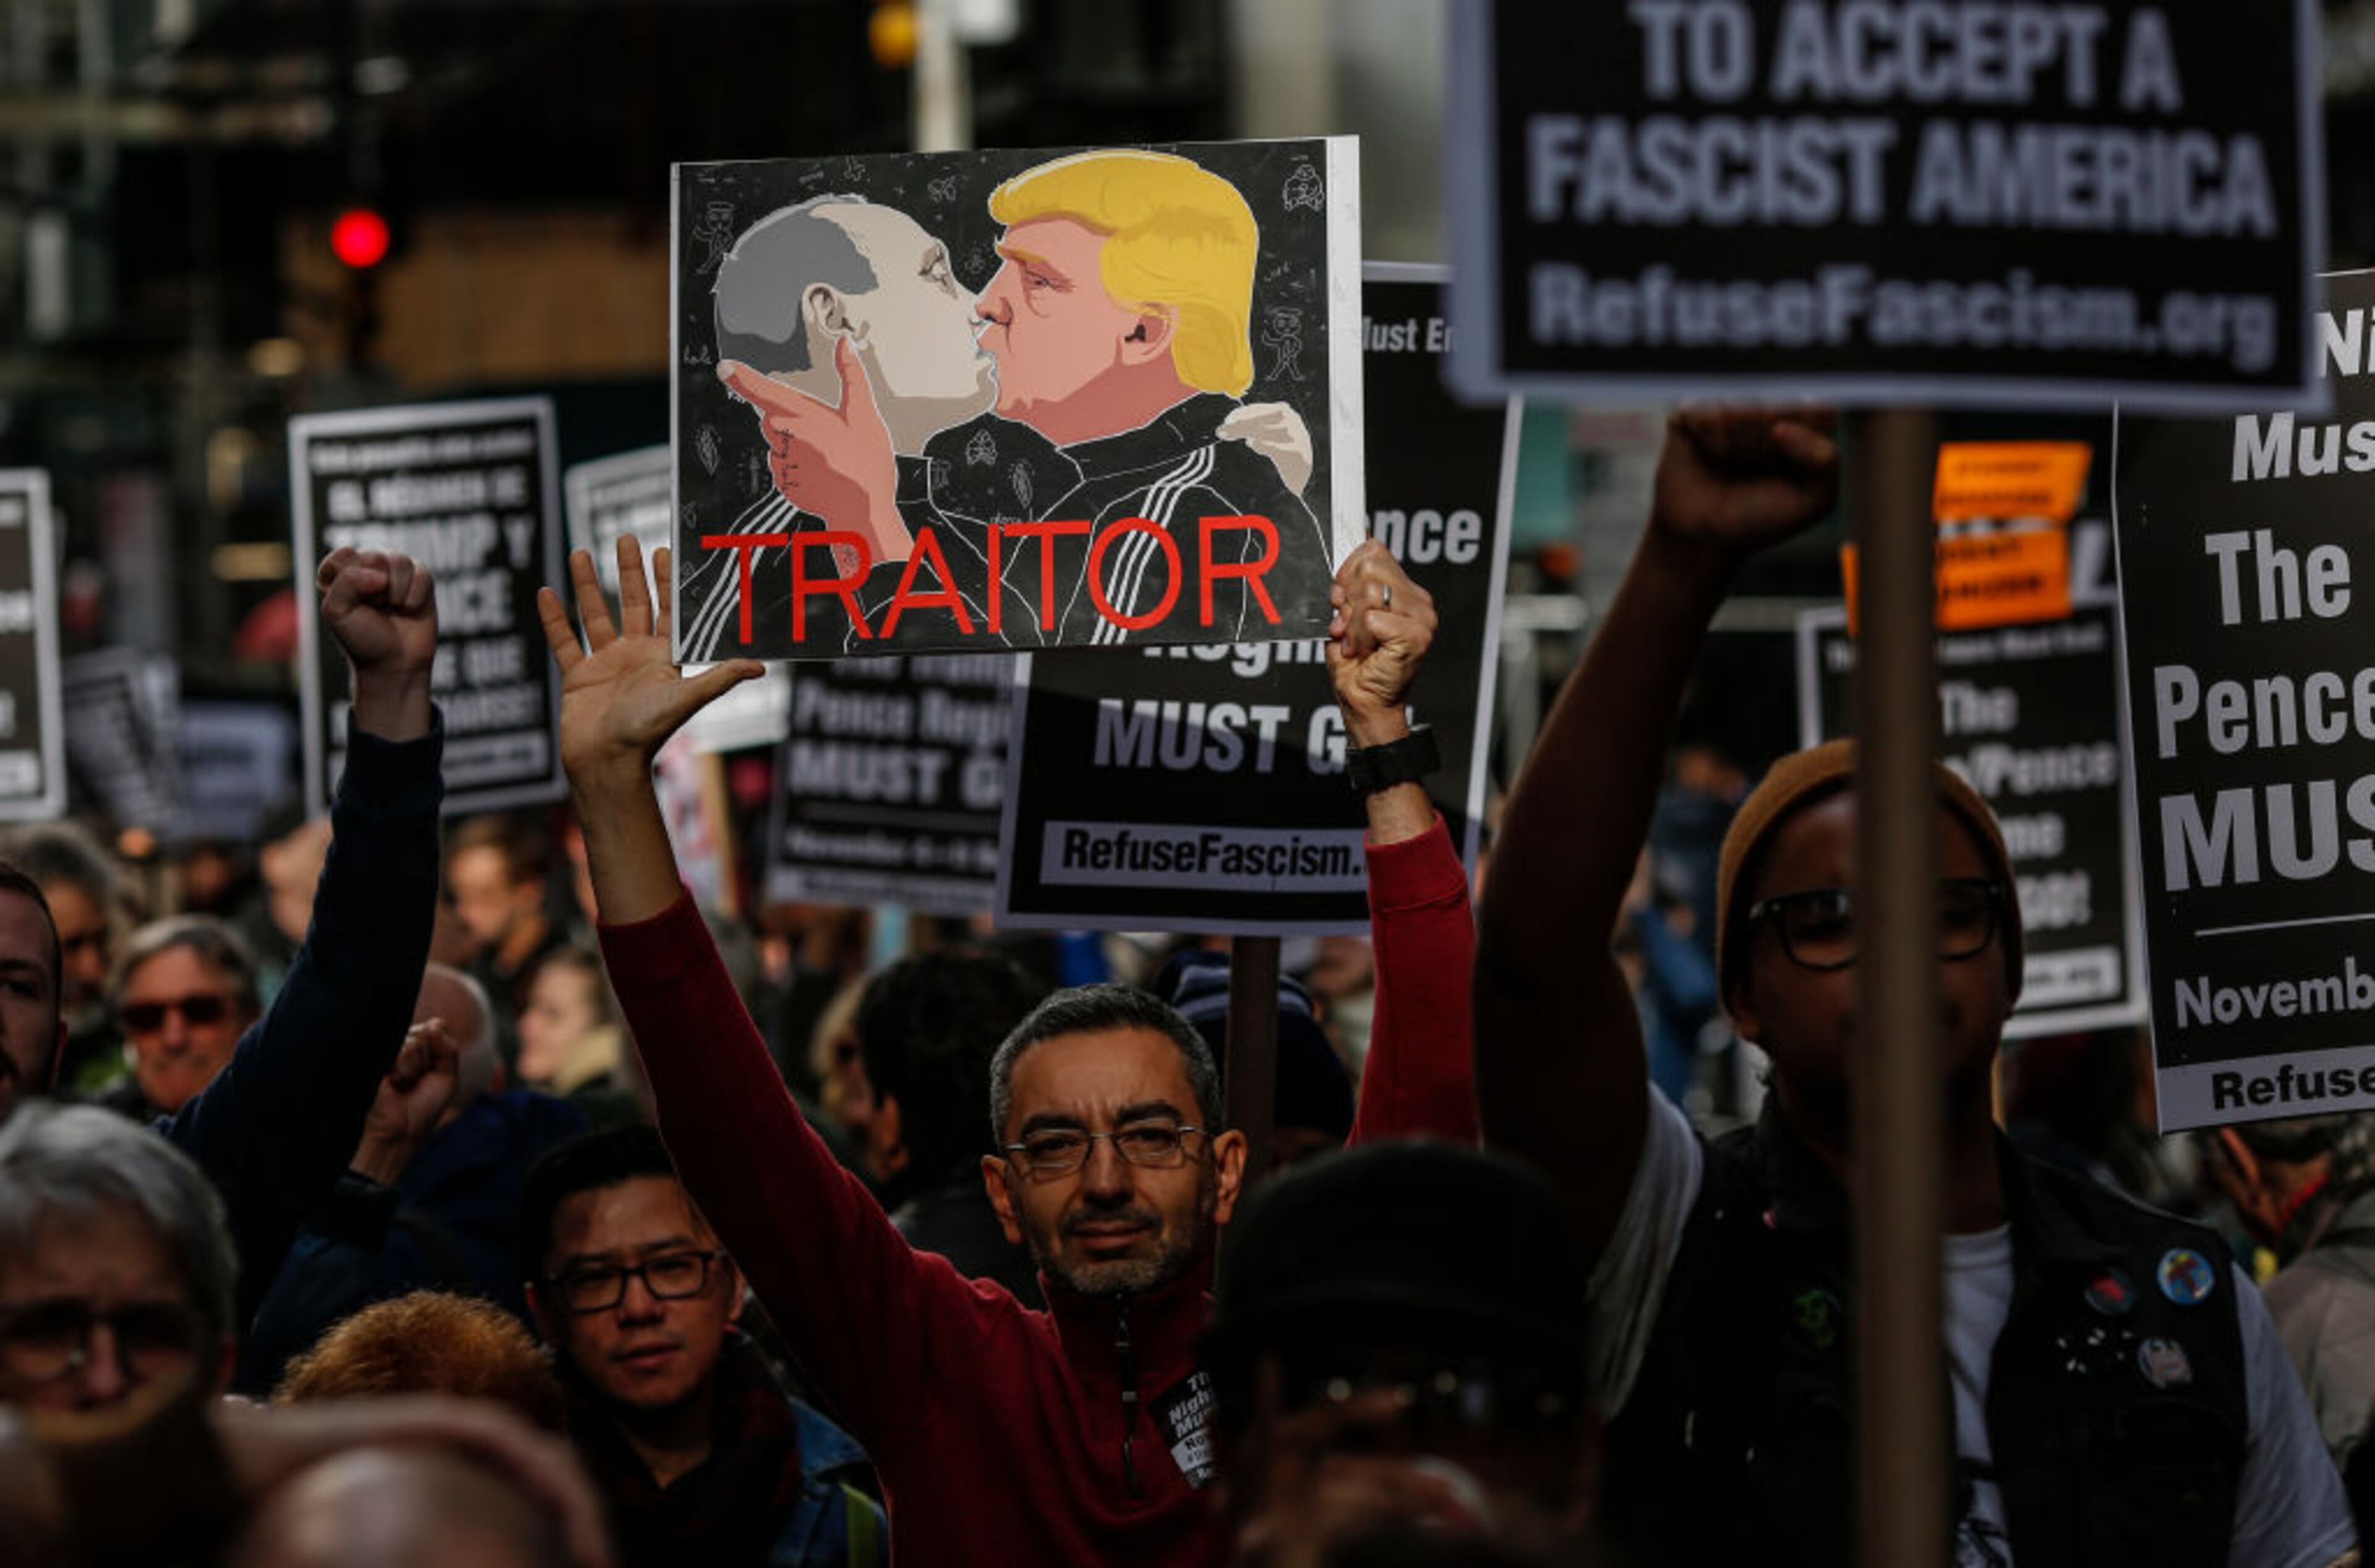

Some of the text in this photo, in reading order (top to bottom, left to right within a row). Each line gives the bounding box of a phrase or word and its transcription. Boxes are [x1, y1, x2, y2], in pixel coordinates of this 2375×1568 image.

[1634, 1, 2183, 113] TO ACCEPT A
[1525, 115, 2279, 238] FASCIST AMERICA
[1530, 262, 2277, 370] RefuseFascism.org
[700, 515, 1282, 644] TRAITOR
[1364, 508, 1482, 565] nce
[2204, 528, 2351, 626] The
[789, 740, 949, 805] MUST
[1093, 698, 1290, 774] MUST
[2174, 956, 2375, 1029] Novemb
